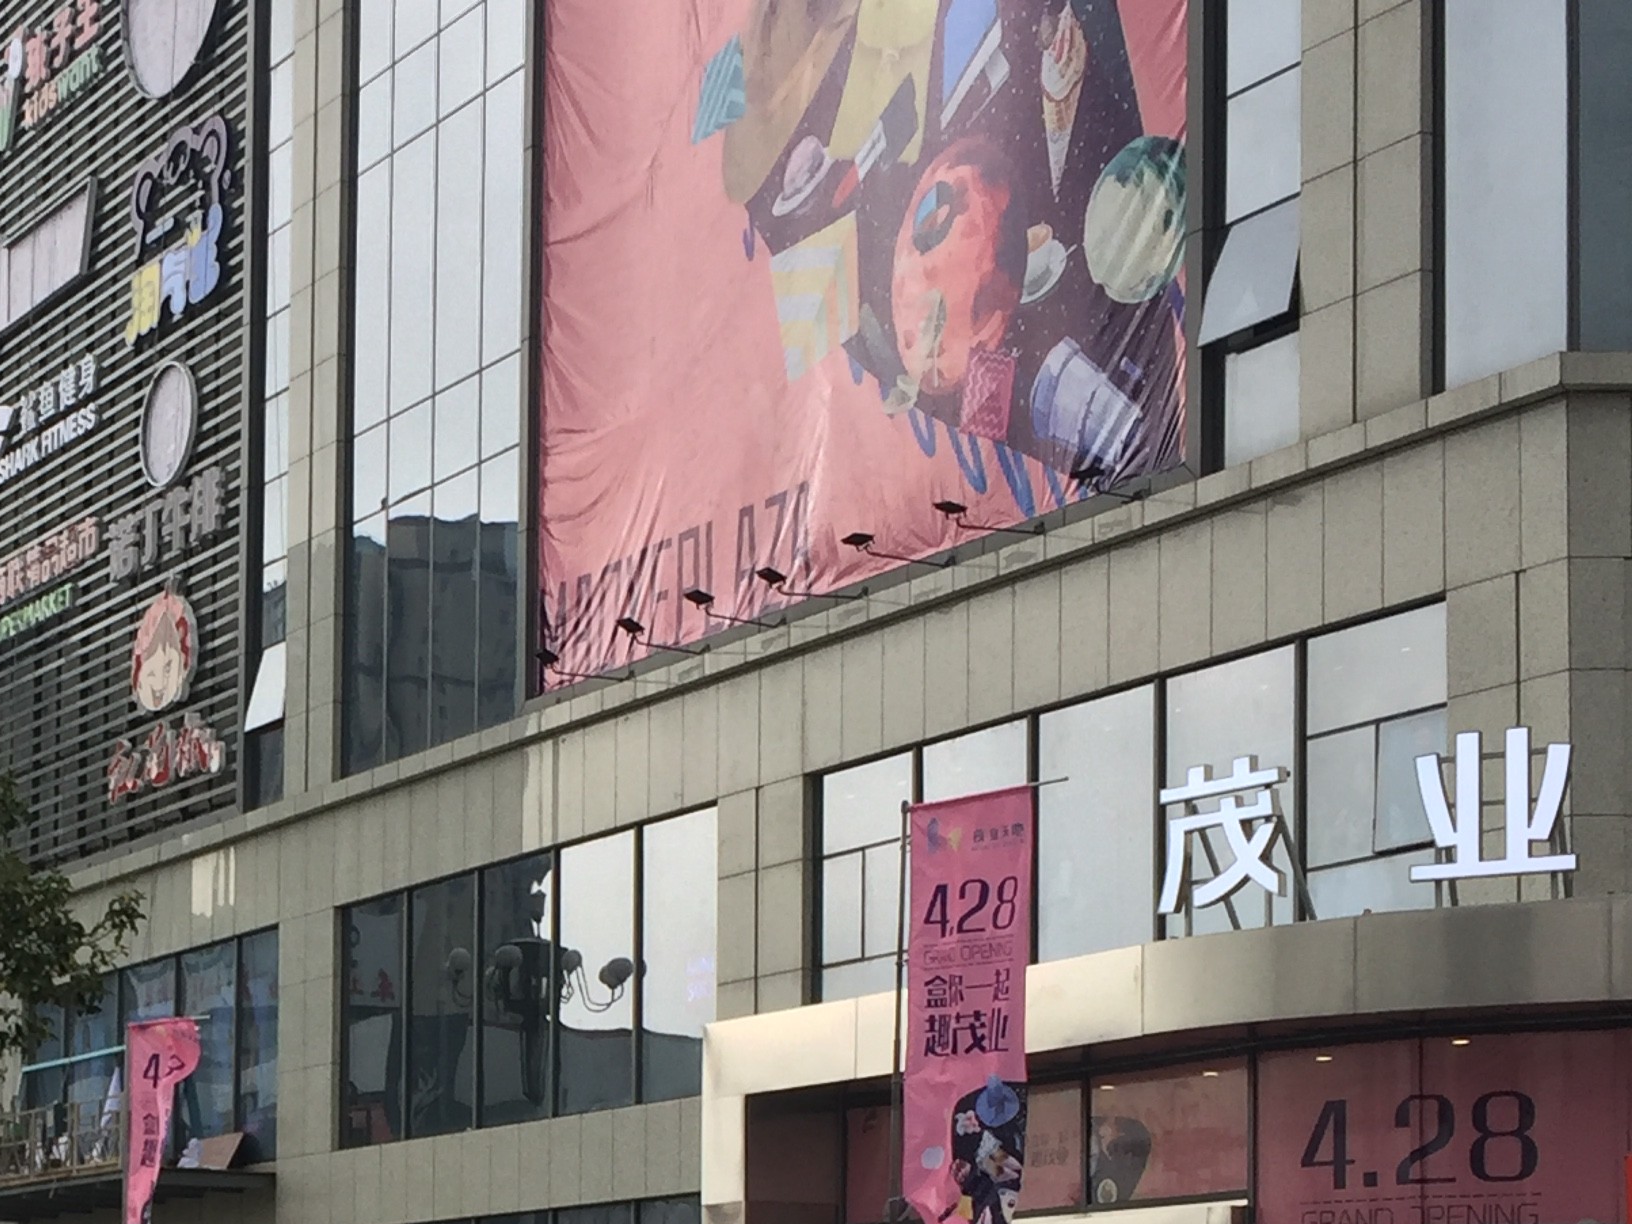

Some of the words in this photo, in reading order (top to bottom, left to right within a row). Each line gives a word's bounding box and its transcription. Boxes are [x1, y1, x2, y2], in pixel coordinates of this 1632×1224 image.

[20, 42, 100, 131] kidswant
[41, 402, 97, 458] FITNESS
[1157, 726, 1577, 914] 茂业
[924, 1007, 1009, 1057] 趣茂业
[1301, 1090, 1539, 1190] 4.28
